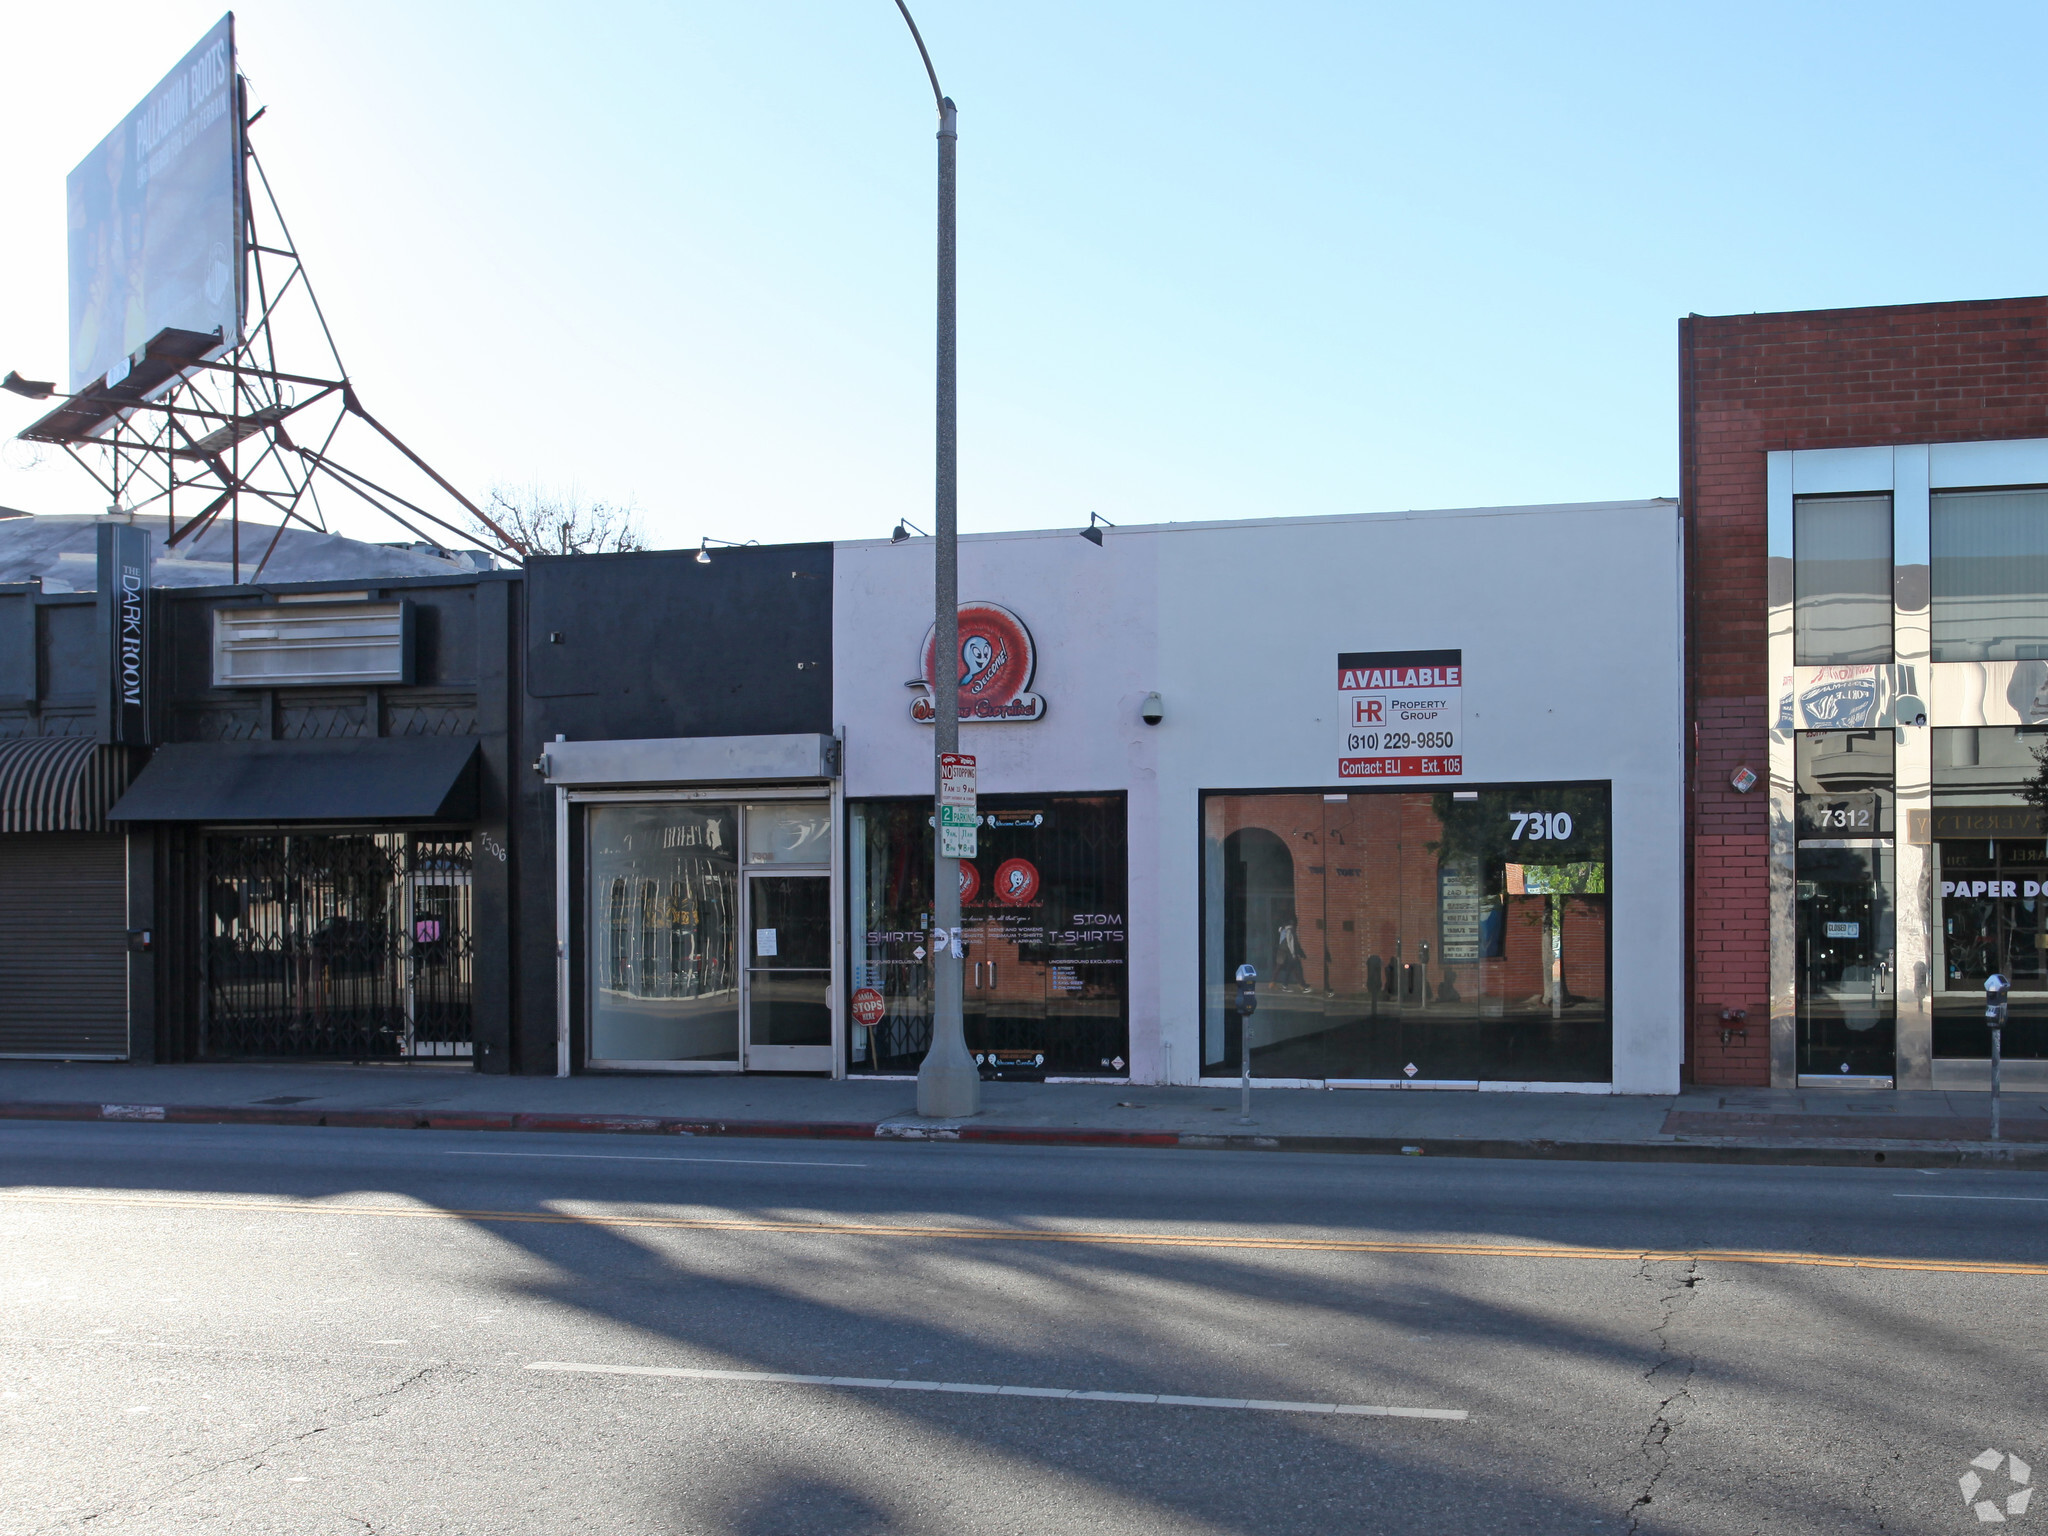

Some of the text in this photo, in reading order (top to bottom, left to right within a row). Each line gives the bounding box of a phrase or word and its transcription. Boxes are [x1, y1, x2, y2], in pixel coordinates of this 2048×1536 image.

[136, 37, 226, 162] PALLADIUM BOOTS
[123, 565, 141, 576] THE
[1342, 667, 1459, 689] AVAILABLE
[1356, 700, 1383, 722] HR
[1347, 732, 1454, 751] (310) 229-9850
[941, 765, 975, 778] NO STOPPING
[1341, 760, 1383, 774] Contact:
[1385, 759, 1400, 774] ELI
[1421, 758, 1440, 773] Ext.
[1443, 758, 1461, 772] 105
[943, 807, 951, 820] 2
[953, 812, 975, 823] PARKING
[1820, 809, 1870, 827] 7312
[1509, 811, 1573, 840] 7310
[480, 832, 507, 861] 7306
[1941, 881, 2017, 898] PAPER
[1073, 914, 1122, 925] STOM
[1828, 923, 1847, 932] CLOSED
[1048, 931, 1124, 941] T-SHIRTS
[852, 999, 883, 1014] STOPS
